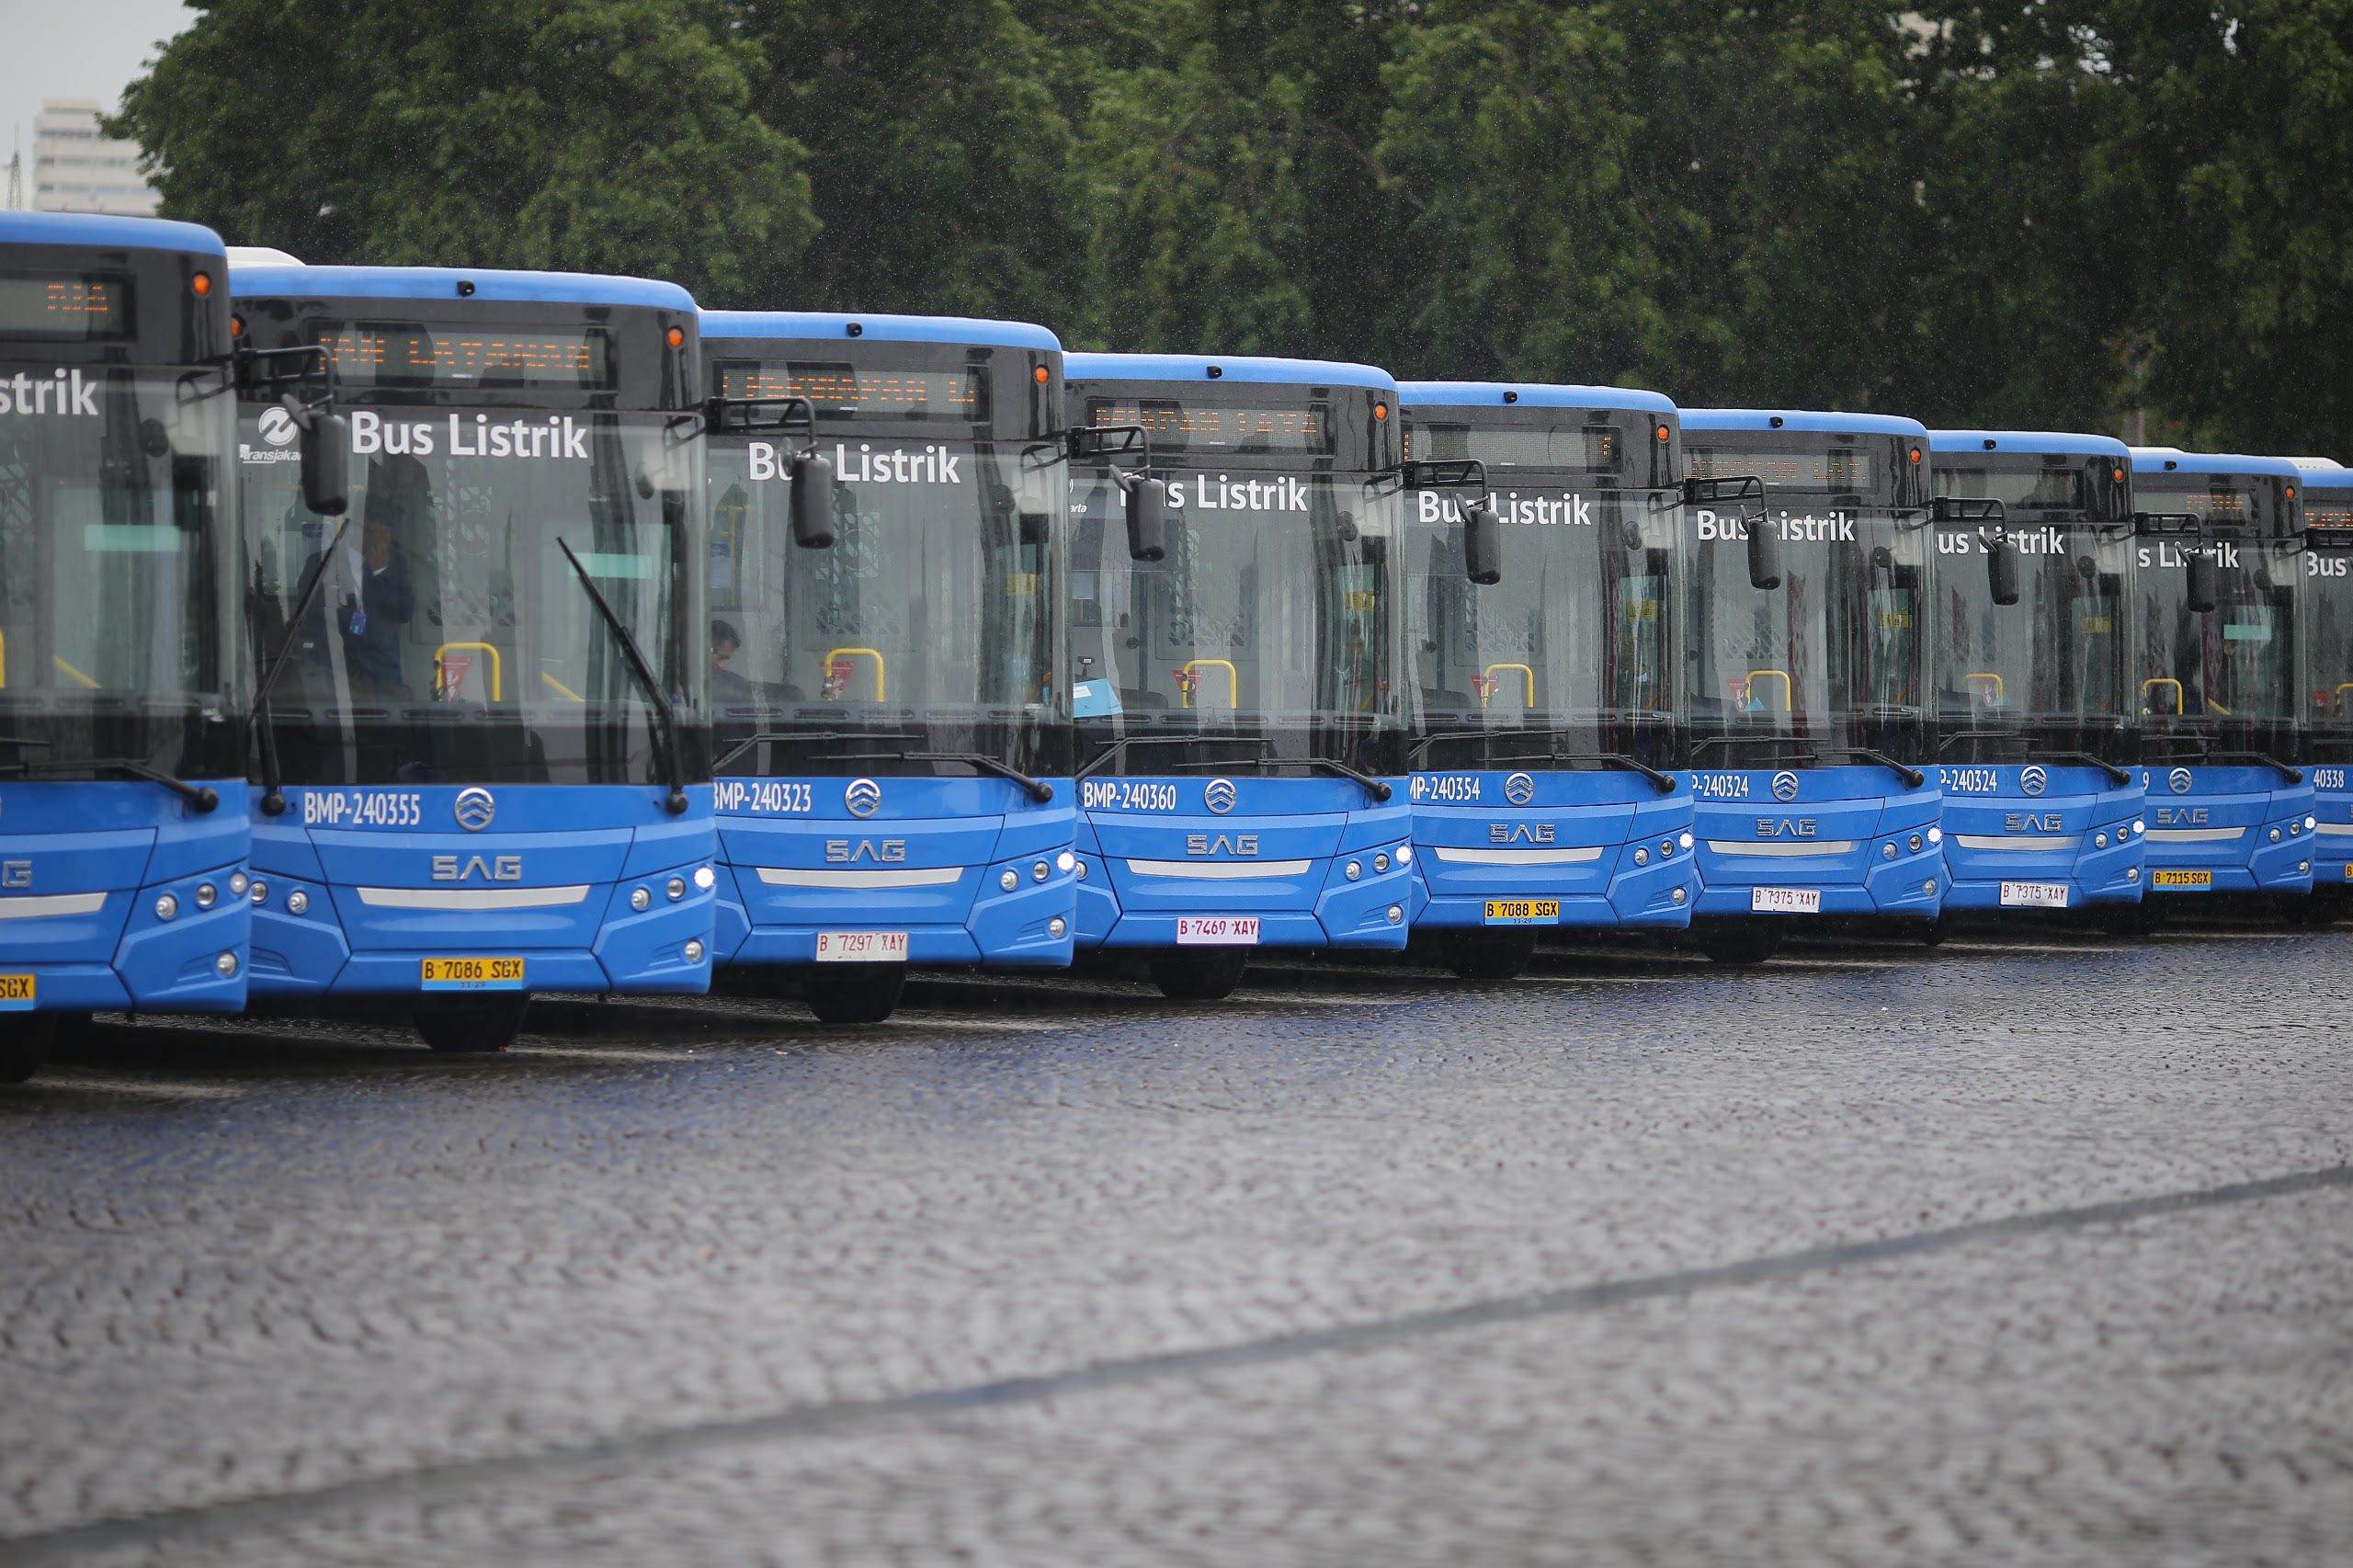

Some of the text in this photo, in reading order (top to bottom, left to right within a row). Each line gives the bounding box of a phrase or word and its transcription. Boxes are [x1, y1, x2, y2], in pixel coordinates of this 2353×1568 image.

[351, 411, 588, 458] Bus Listrik
[836, 443, 961, 483] Listrik
[1198, 474, 1308, 511] Listrik
[1490, 492, 1591, 526] Listrik
[1768, 510, 1855, 541] istrik
[1936, 533, 1969, 554] us
[1084, 782, 1176, 811] BMP-240360
[304, 792, 420, 825] BMP-240355
[2157, 809, 2209, 824] SAG
[1756, 819, 1817, 836] SAG
[2005, 813, 2063, 832] SAG
[1489, 824, 1555, 843] SAG
[825, 839, 905, 862] SAG
[1187, 835, 1258, 855] SAG
[432, 856, 522, 881] SAG
[2155, 872, 2209, 883] B 7115 SGX
[2347, 866, 2352, 876] B
[1756, 890, 1818, 905] B 7375 XAY
[2004, 884, 2066, 900] B 7375 XAY
[1487, 903, 1557, 916] B 7088 SGX
[1180, 920, 1256, 935] B 7469 XAY
[820, 935, 904, 951] B 7297 XAY
[425, 960, 520, 979] B 7086 SGX
